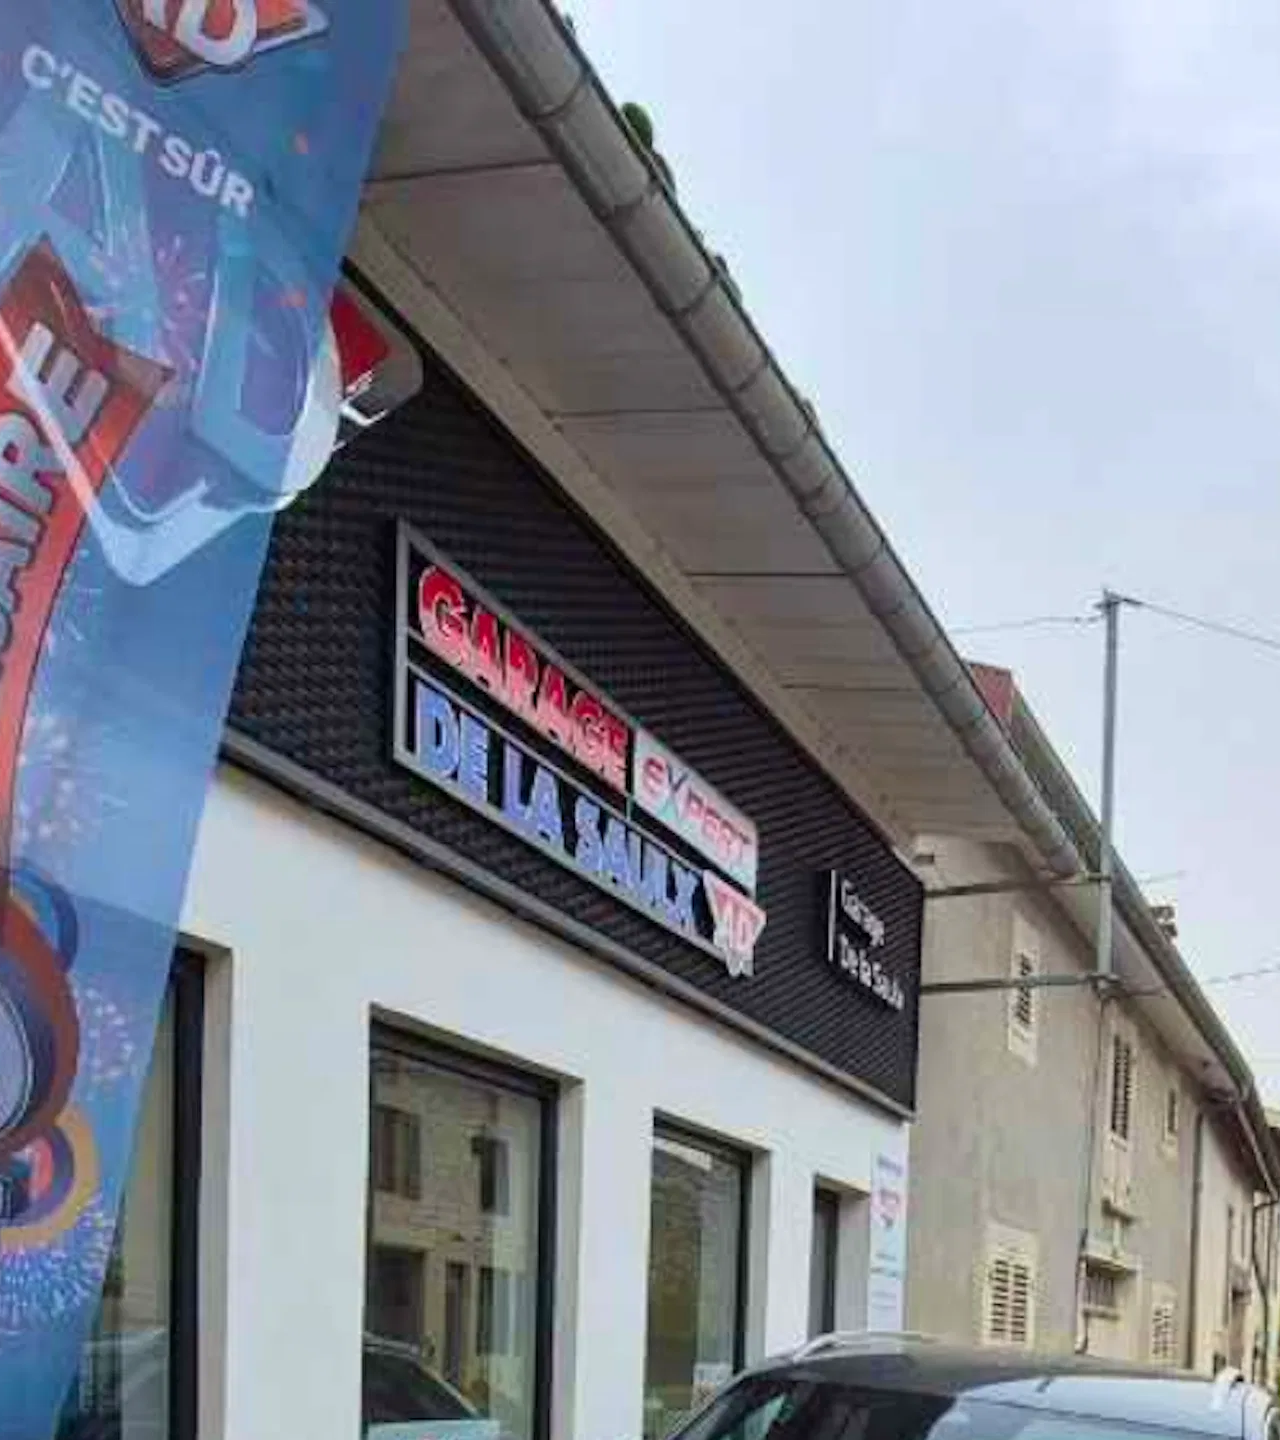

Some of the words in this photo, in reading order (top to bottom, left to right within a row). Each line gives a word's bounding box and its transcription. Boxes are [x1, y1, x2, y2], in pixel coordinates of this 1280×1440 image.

[20, 43, 162, 154] C'EST
[158, 136, 256, 218] SÛR
[419, 564, 628, 794] GARAGE
[417, 680, 489, 803] DE
[503, 740, 565, 851] LA
[573, 794, 702, 937] SAULX
